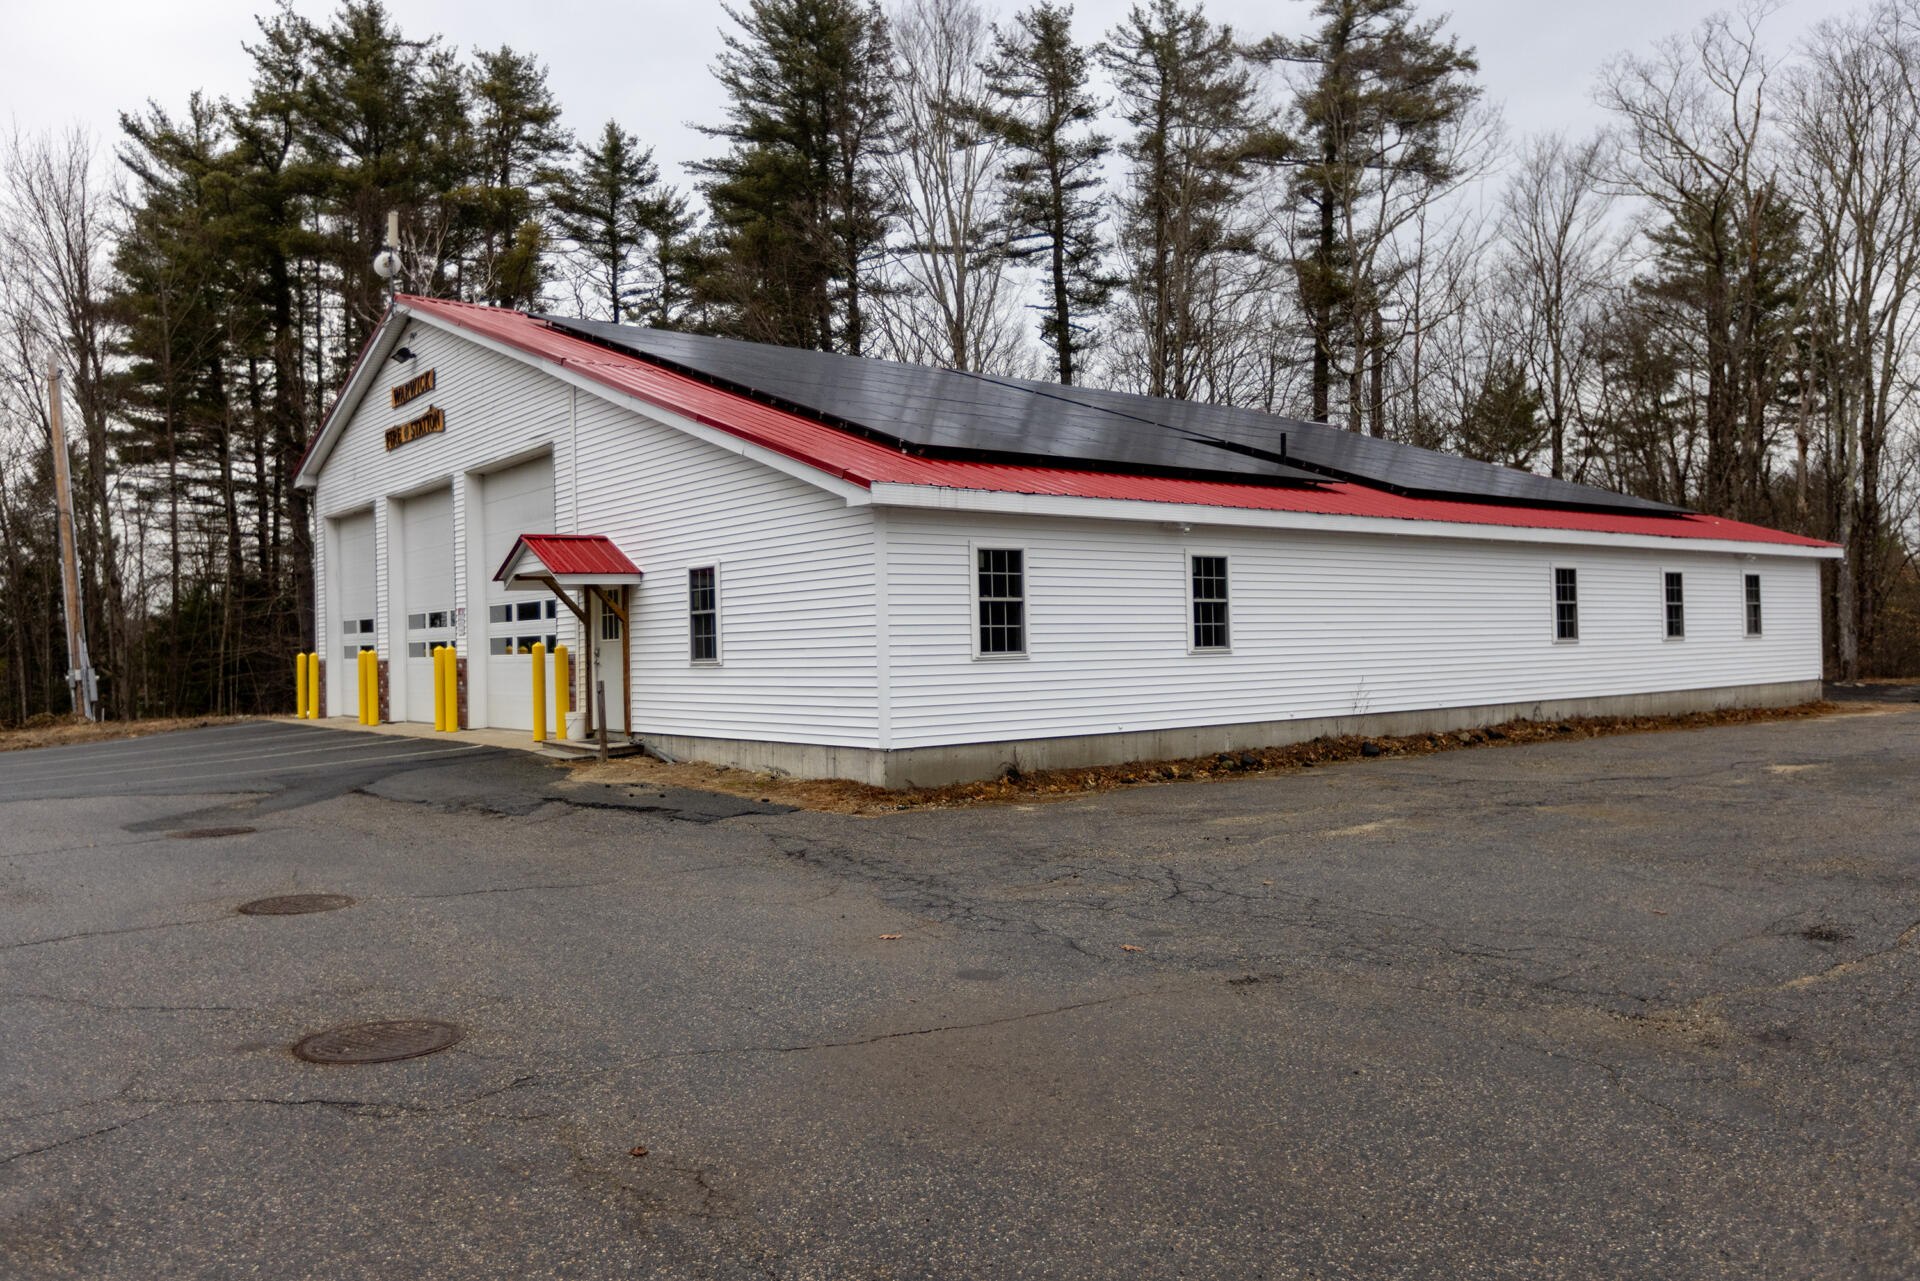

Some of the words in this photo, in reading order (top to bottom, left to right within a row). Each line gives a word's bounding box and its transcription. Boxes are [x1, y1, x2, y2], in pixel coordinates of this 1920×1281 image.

[393, 371, 431, 405] WARWICK
[385, 429, 402, 451] FIRE
[410, 410, 441, 441] STATION
